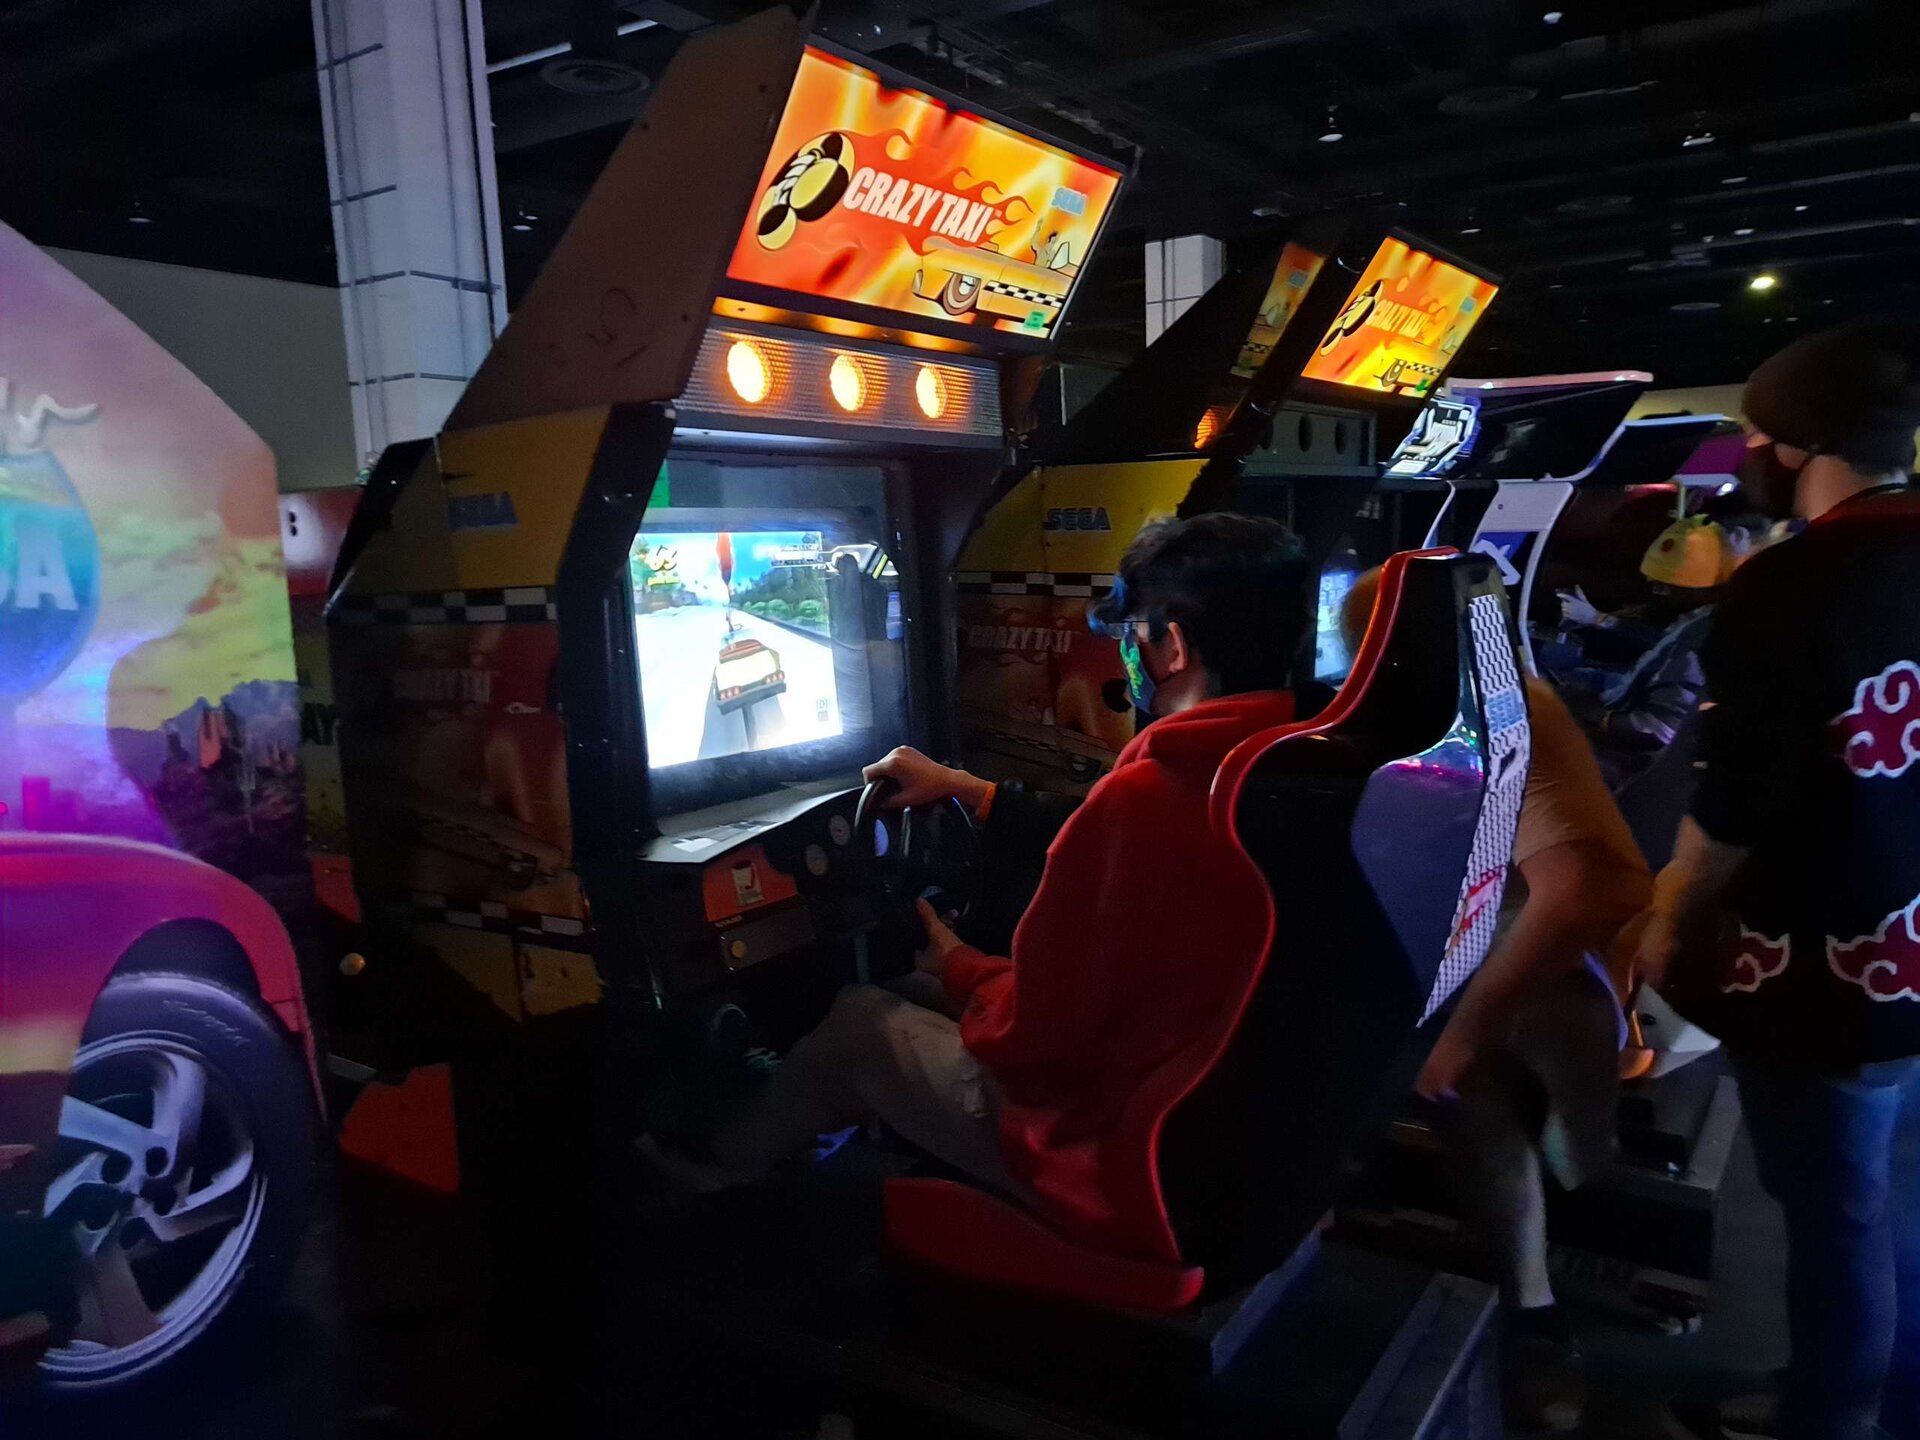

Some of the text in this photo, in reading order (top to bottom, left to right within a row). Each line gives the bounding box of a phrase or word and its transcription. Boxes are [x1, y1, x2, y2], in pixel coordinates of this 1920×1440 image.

[843, 167, 993, 243] CRAZY TAXI
[1045, 507, 1111, 531] SEGA
